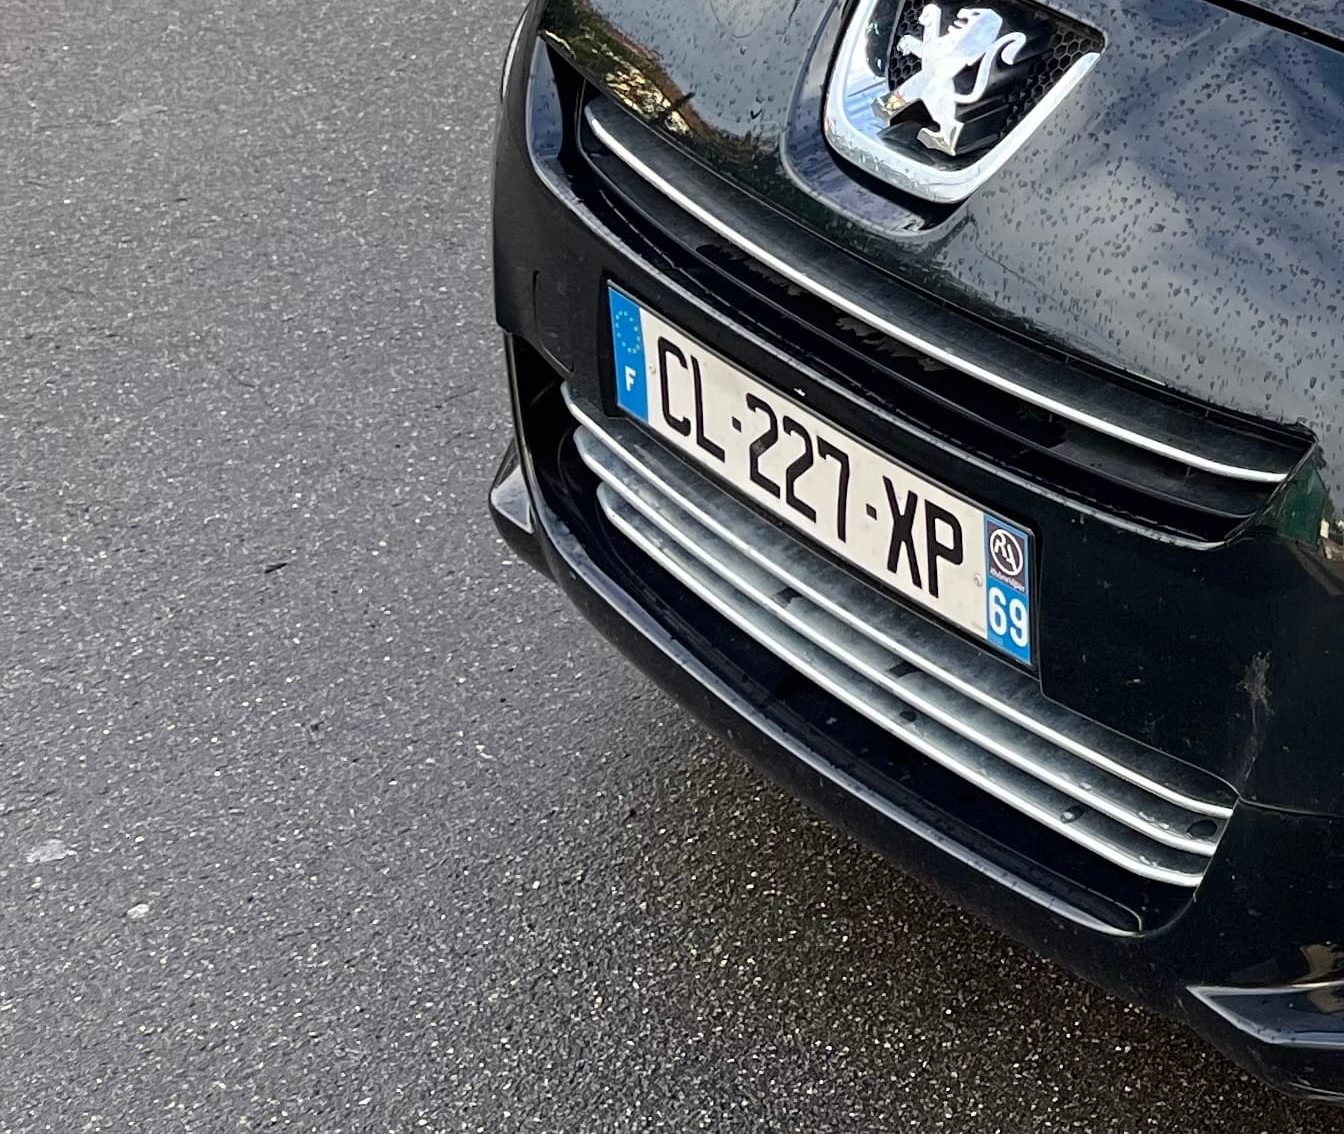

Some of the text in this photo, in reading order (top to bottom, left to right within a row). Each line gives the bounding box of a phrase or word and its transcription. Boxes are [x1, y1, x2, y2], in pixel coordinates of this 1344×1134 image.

[624, 365, 636, 393] F
[657, 335, 964, 600] CL-227-XP
[988, 586, 1029, 649] 69
